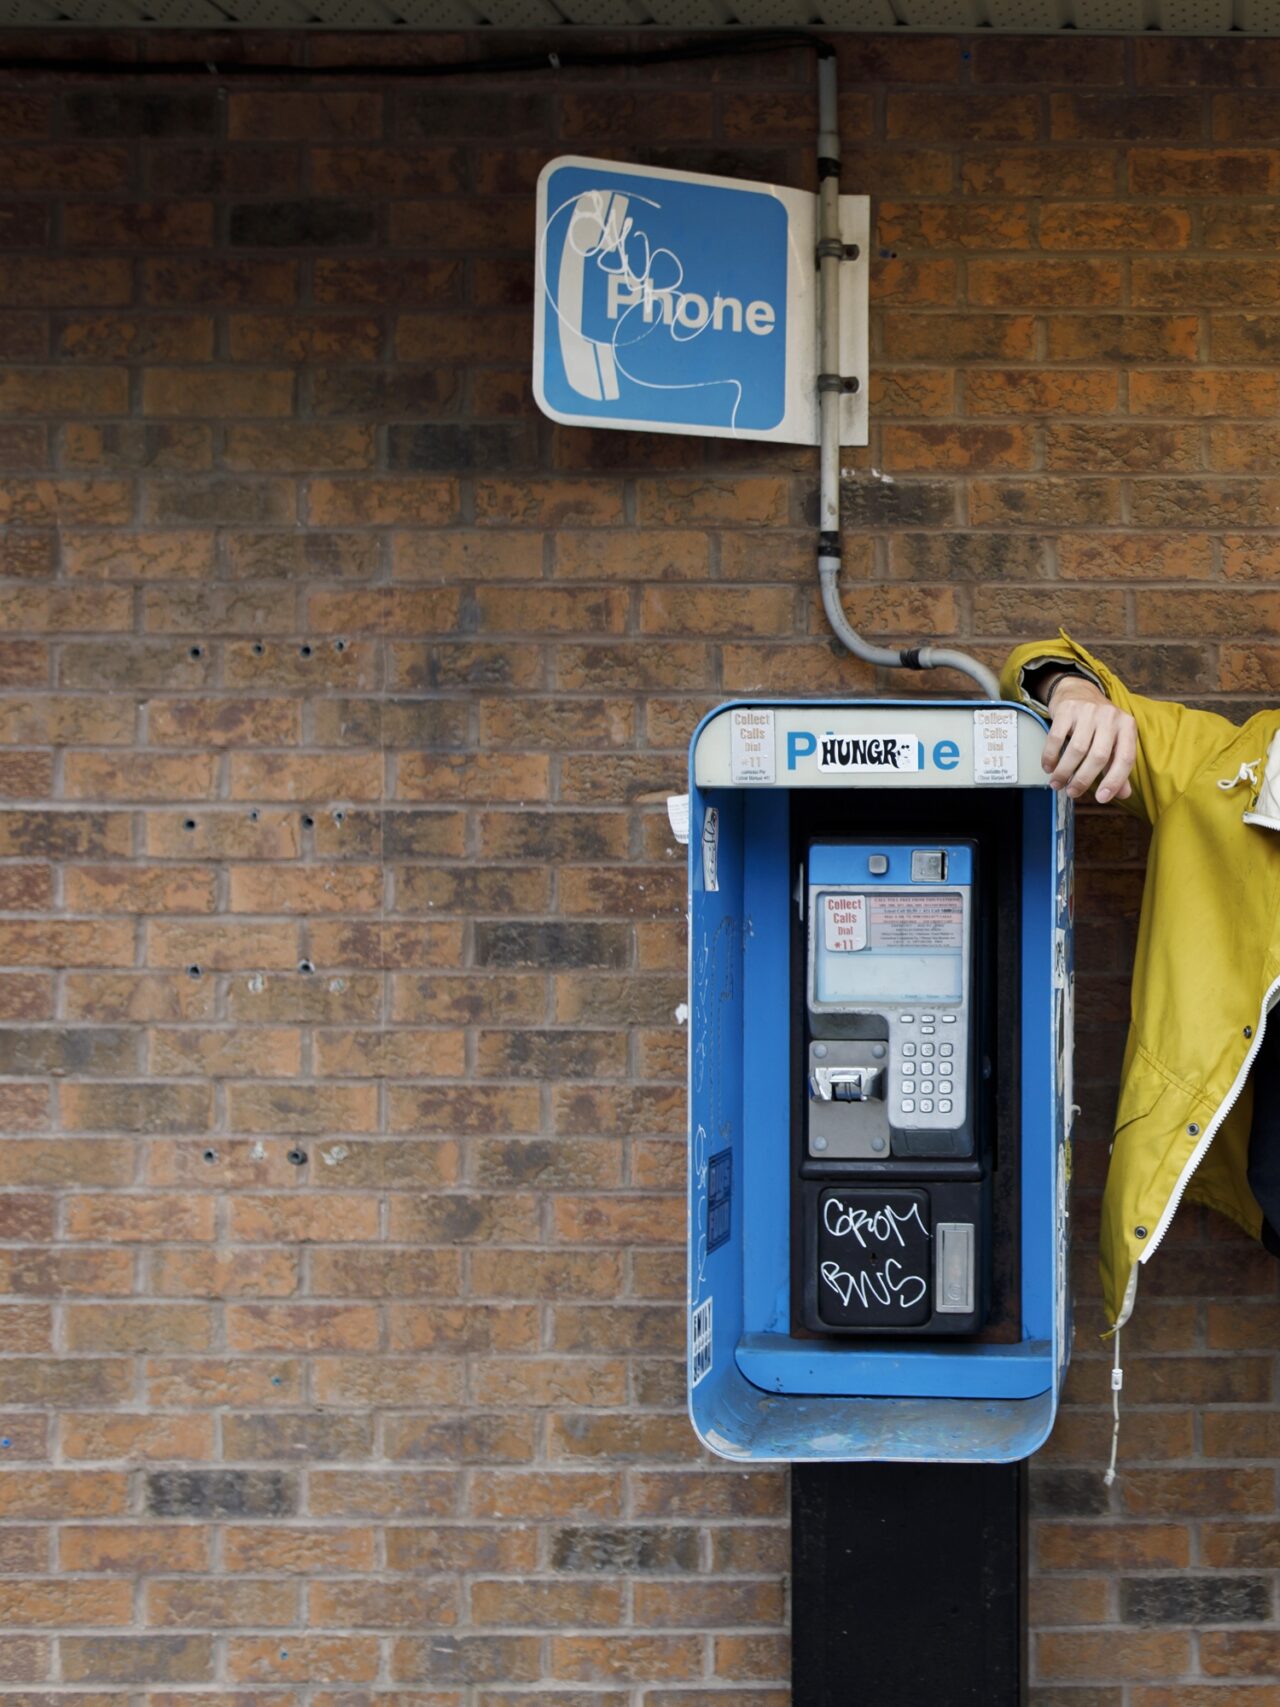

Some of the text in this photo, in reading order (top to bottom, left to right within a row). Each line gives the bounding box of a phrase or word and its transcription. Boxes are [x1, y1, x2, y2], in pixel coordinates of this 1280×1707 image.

[607, 273, 776, 336] Phone
[735, 713, 770, 725] Collect
[977, 713, 1013, 725] Collect
[740, 728, 765, 740] Calls
[983, 728, 1008, 739] Calls
[744, 742, 761, 752] Dial
[987, 742, 1004, 752] Dial
[821, 738, 910, 770] HUNGR
[828, 899, 862, 911] Collect
[833, 912, 857, 924] Calls
[837, 926, 854, 936] Dial
